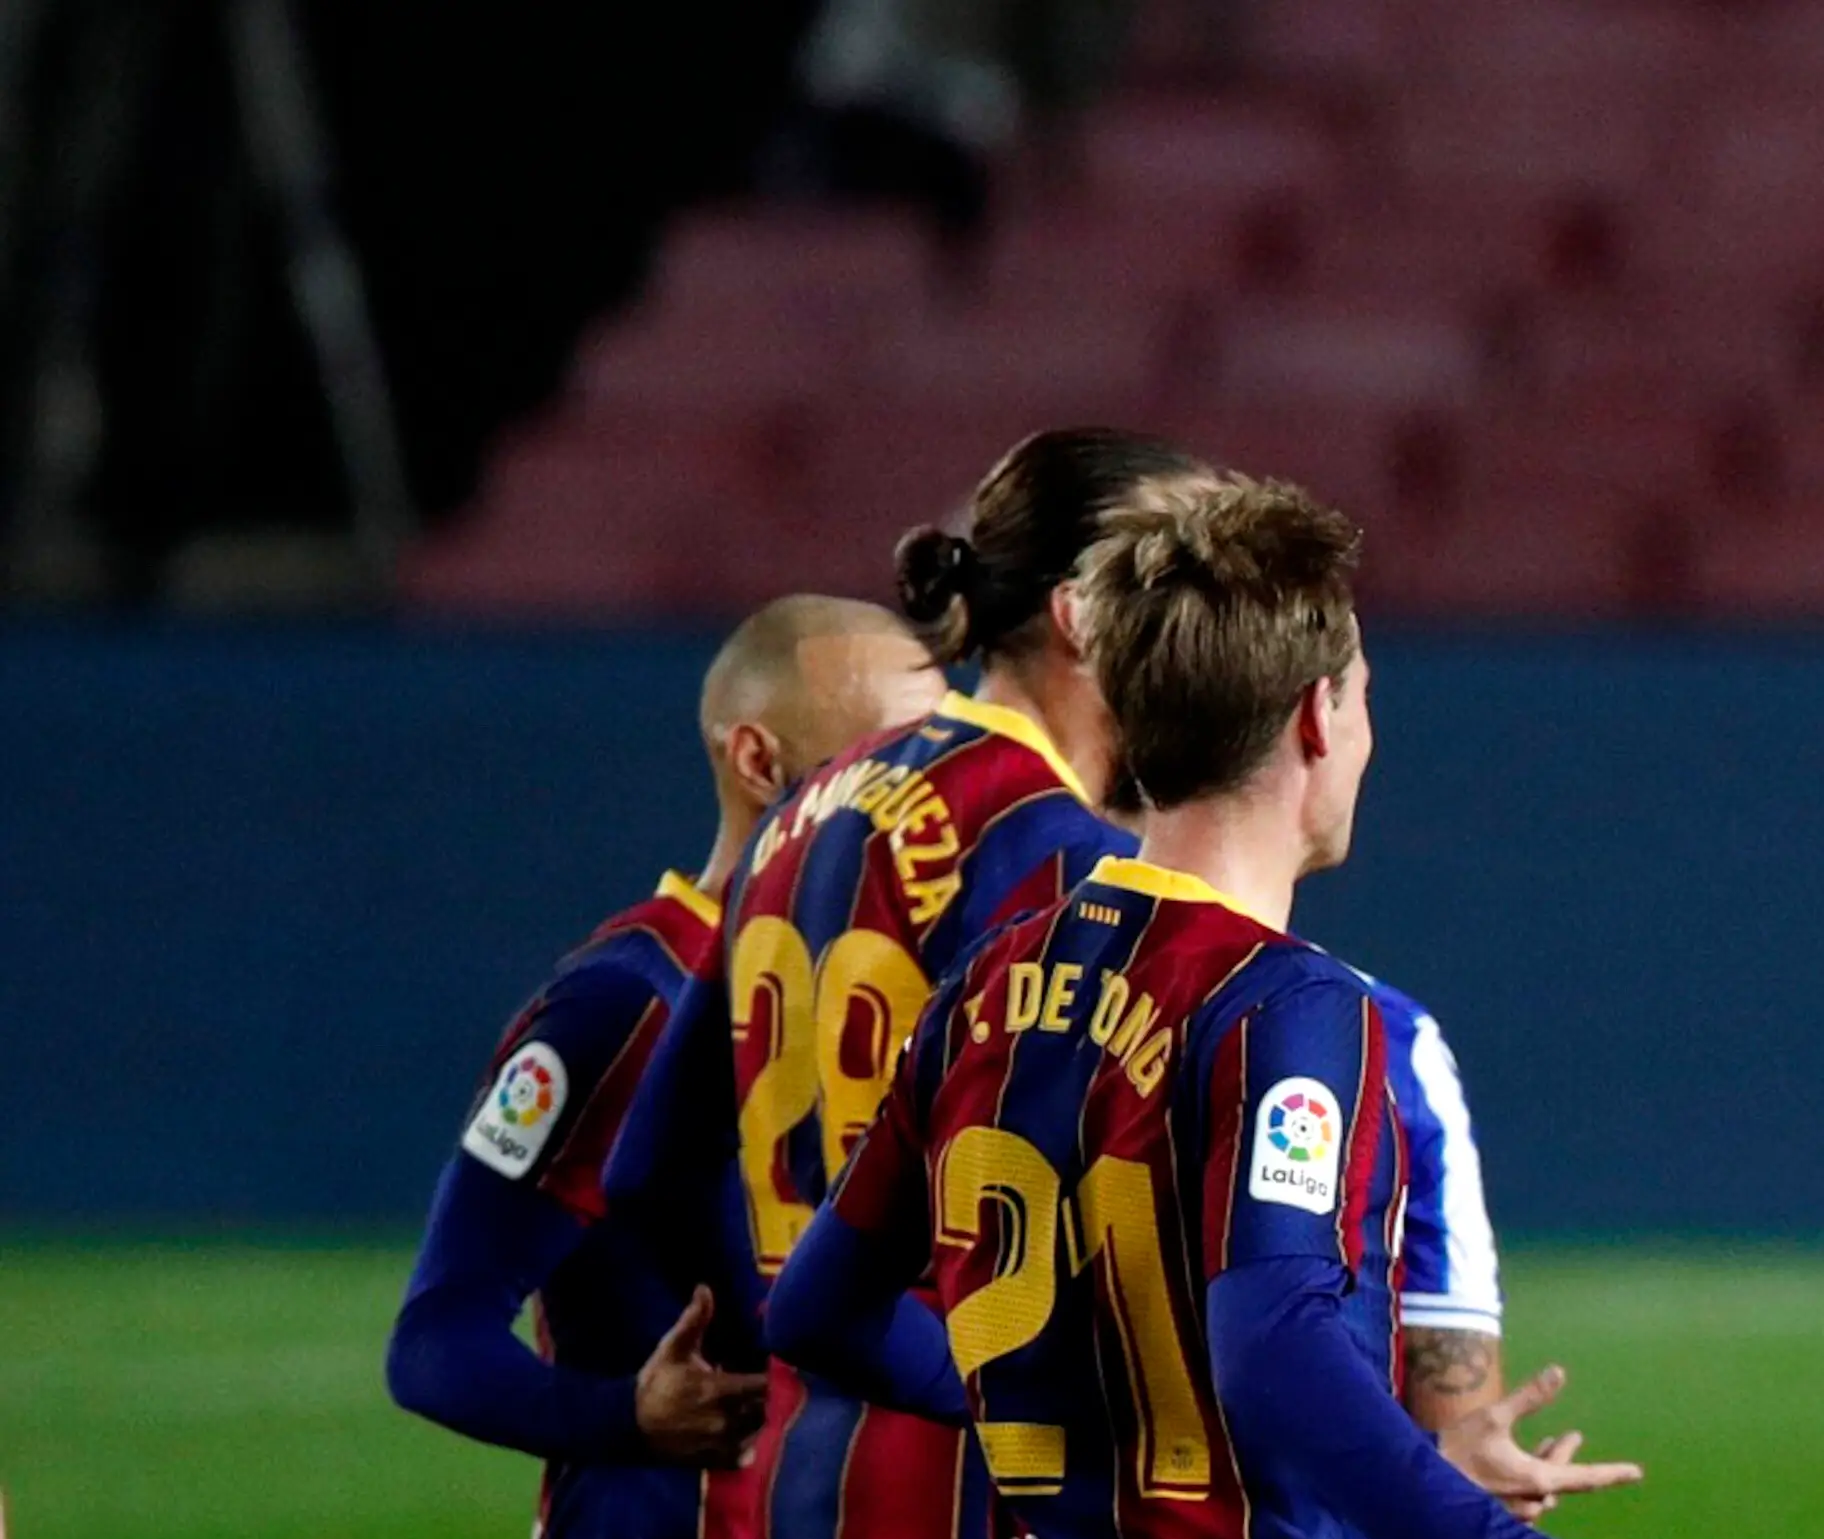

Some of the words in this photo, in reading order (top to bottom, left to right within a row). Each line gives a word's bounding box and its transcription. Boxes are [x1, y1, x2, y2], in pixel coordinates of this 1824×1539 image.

[731, 914, 937, 1276] 28
[1004, 961, 1083, 1034] DE
[1261, 1164, 1328, 1197] LaLiga
[935, 1125, 1212, 1499] 21
